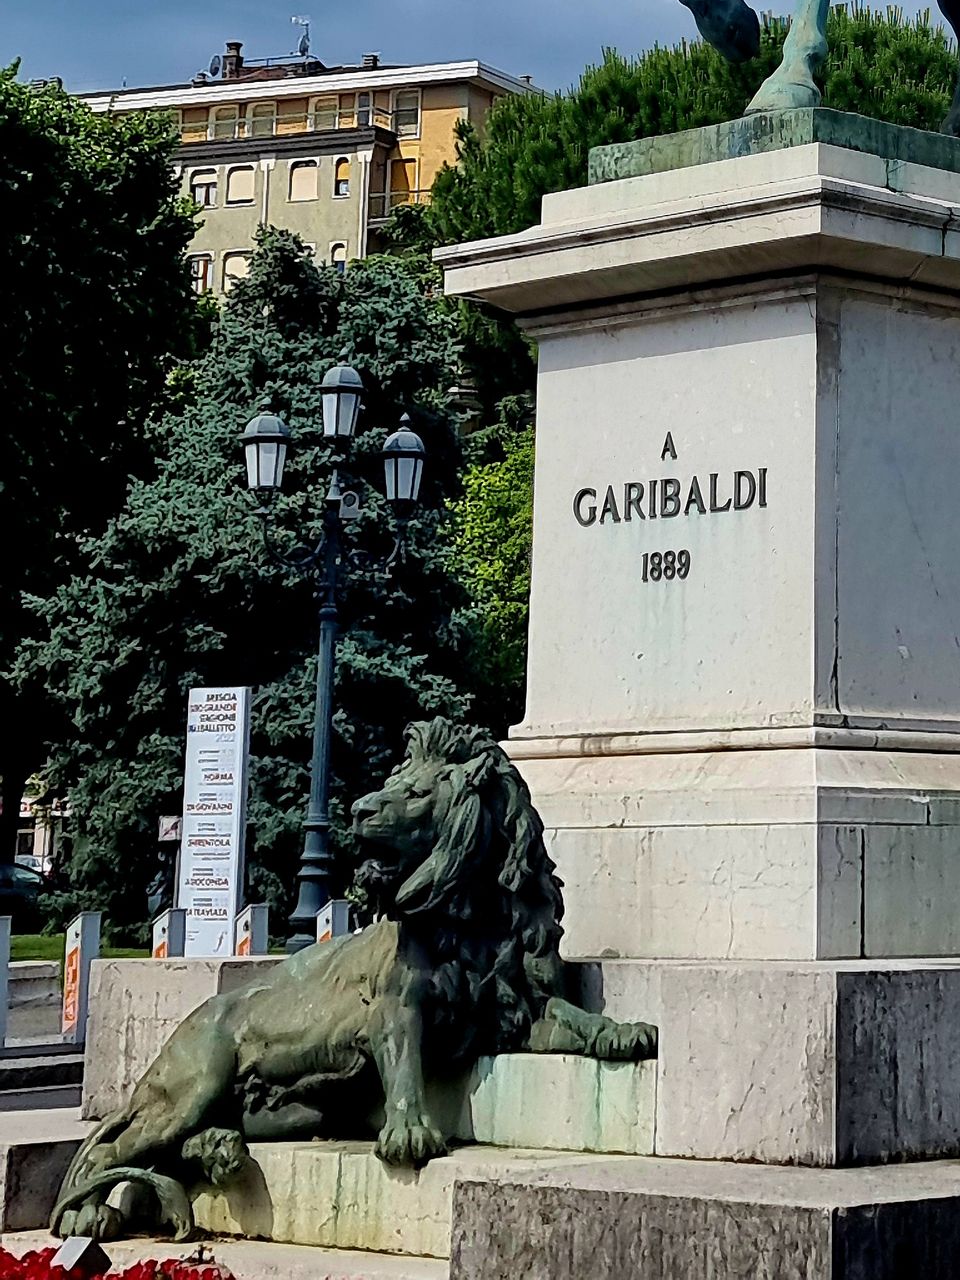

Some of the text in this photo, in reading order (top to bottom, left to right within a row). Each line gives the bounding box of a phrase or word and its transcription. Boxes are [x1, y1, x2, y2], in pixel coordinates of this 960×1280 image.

[660, 431, 678, 461] A
[572, 467, 768, 527] GARIBALDI
[641, 549, 691, 583] 1889
[206, 693, 237, 702] BRESCIA
